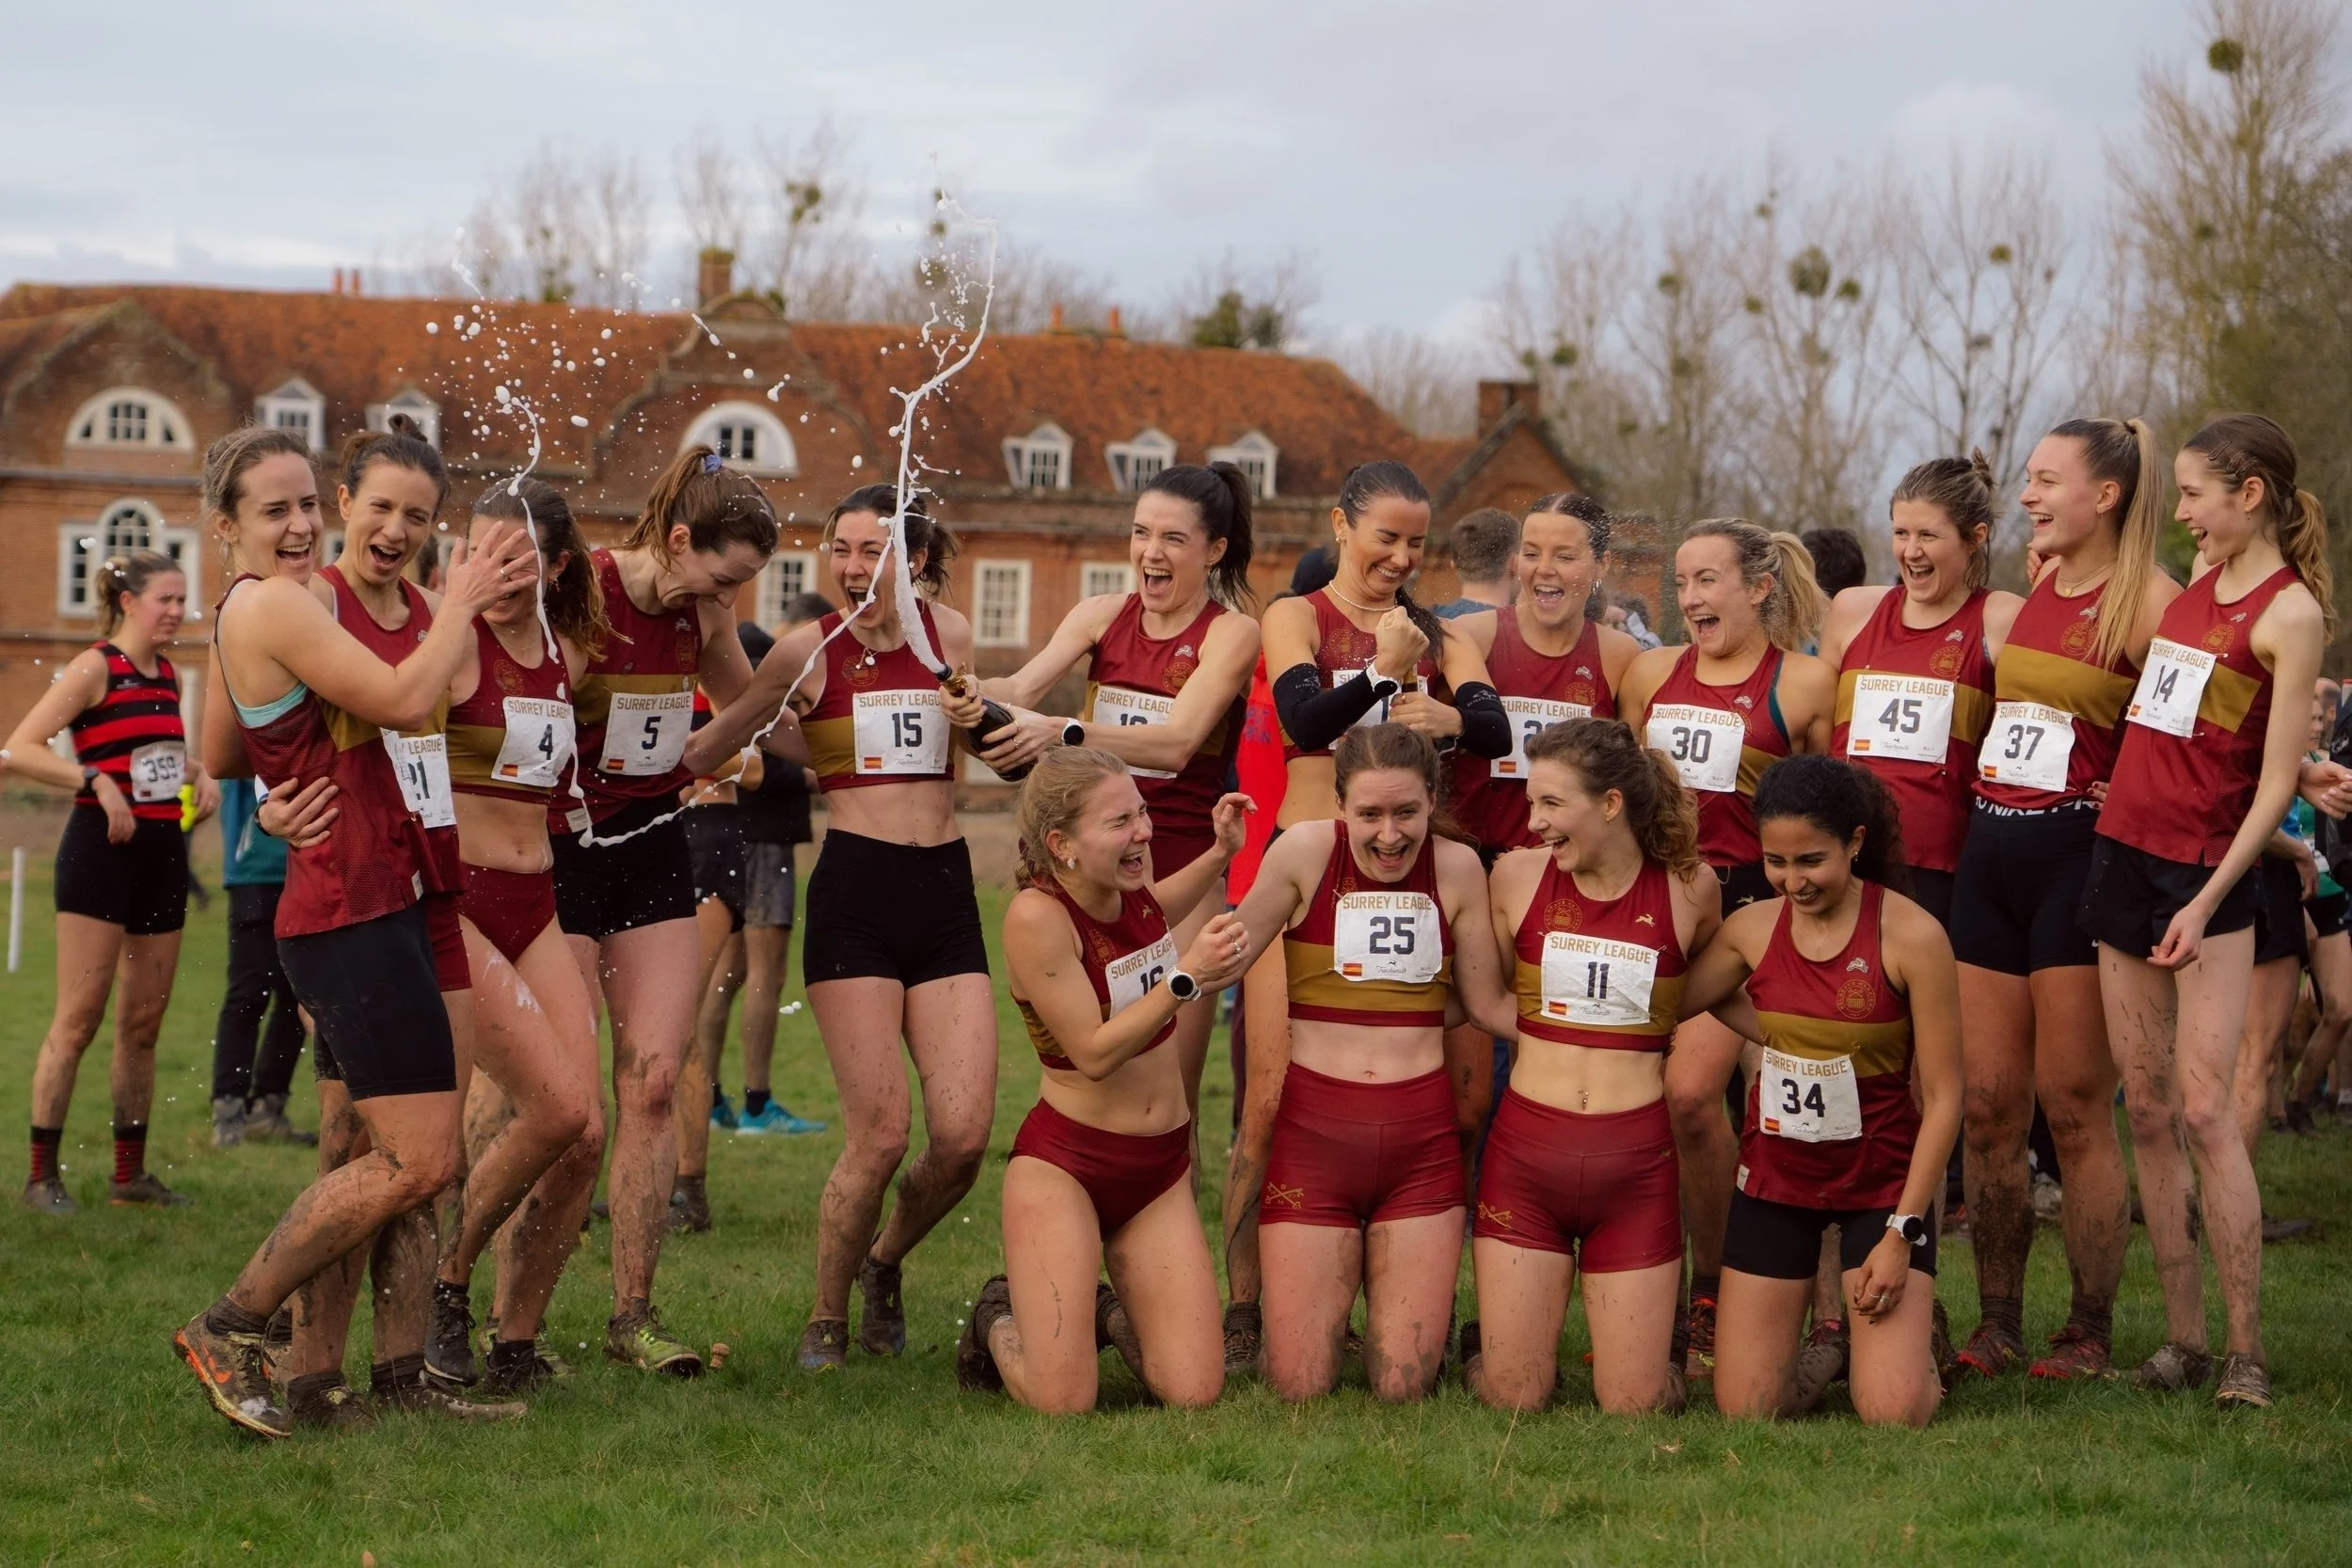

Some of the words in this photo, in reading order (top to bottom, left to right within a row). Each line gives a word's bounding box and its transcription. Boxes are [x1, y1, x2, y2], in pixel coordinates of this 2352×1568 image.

[2152, 642, 2177, 659] SURREY
[2175, 649, 2210, 670] LEAGUE
[1861, 678, 1903, 692] SURREY
[1906, 681, 1949, 697] LEAGUE
[2152, 664, 2180, 704] 14
[508, 700, 543, 716] SURREY
[617, 695, 658, 711] SURREY
[659, 695, 690, 710] LEAGUE
[860, 693, 904, 707] SURREY
[908, 693, 941, 705] LEAGU
[1099, 690, 1136, 707] SURREY
[1138, 697, 1173, 714] LEAGU
[1502, 700, 1543, 716] SURREY
[1546, 704, 1586, 718] LEAGUE
[1999, 705, 2029, 719] SURREY
[891, 712, 923, 748] 15
[1656, 707, 1694, 721] SURREY
[1697, 711, 1740, 728] LEAGUE
[1878, 698, 1922, 735] 45
[408, 737, 443, 755] LEAGUE
[538, 723, 553, 761] 4
[642, 716, 661, 751] 5
[1523, 720, 1558, 753] 2
[1671, 725, 1713, 764] 30
[2005, 723, 2045, 761] 37
[1343, 895, 1391, 911] SURREY
[1396, 895, 1432, 911] LEAGUE
[1369, 915, 1415, 956] 25
[1111, 951, 1149, 980] SURREY
[1150, 937, 1172, 960] LEAG
[1550, 936, 1601, 955] SURREY
[1603, 943, 1651, 964] LEAGUE
[1587, 961, 1610, 1000] 11
[1765, 1052, 1798, 1074] SURREY
[1801, 1060, 1848, 1078] LEAGUE
[1781, 1077, 1826, 1118] 34
